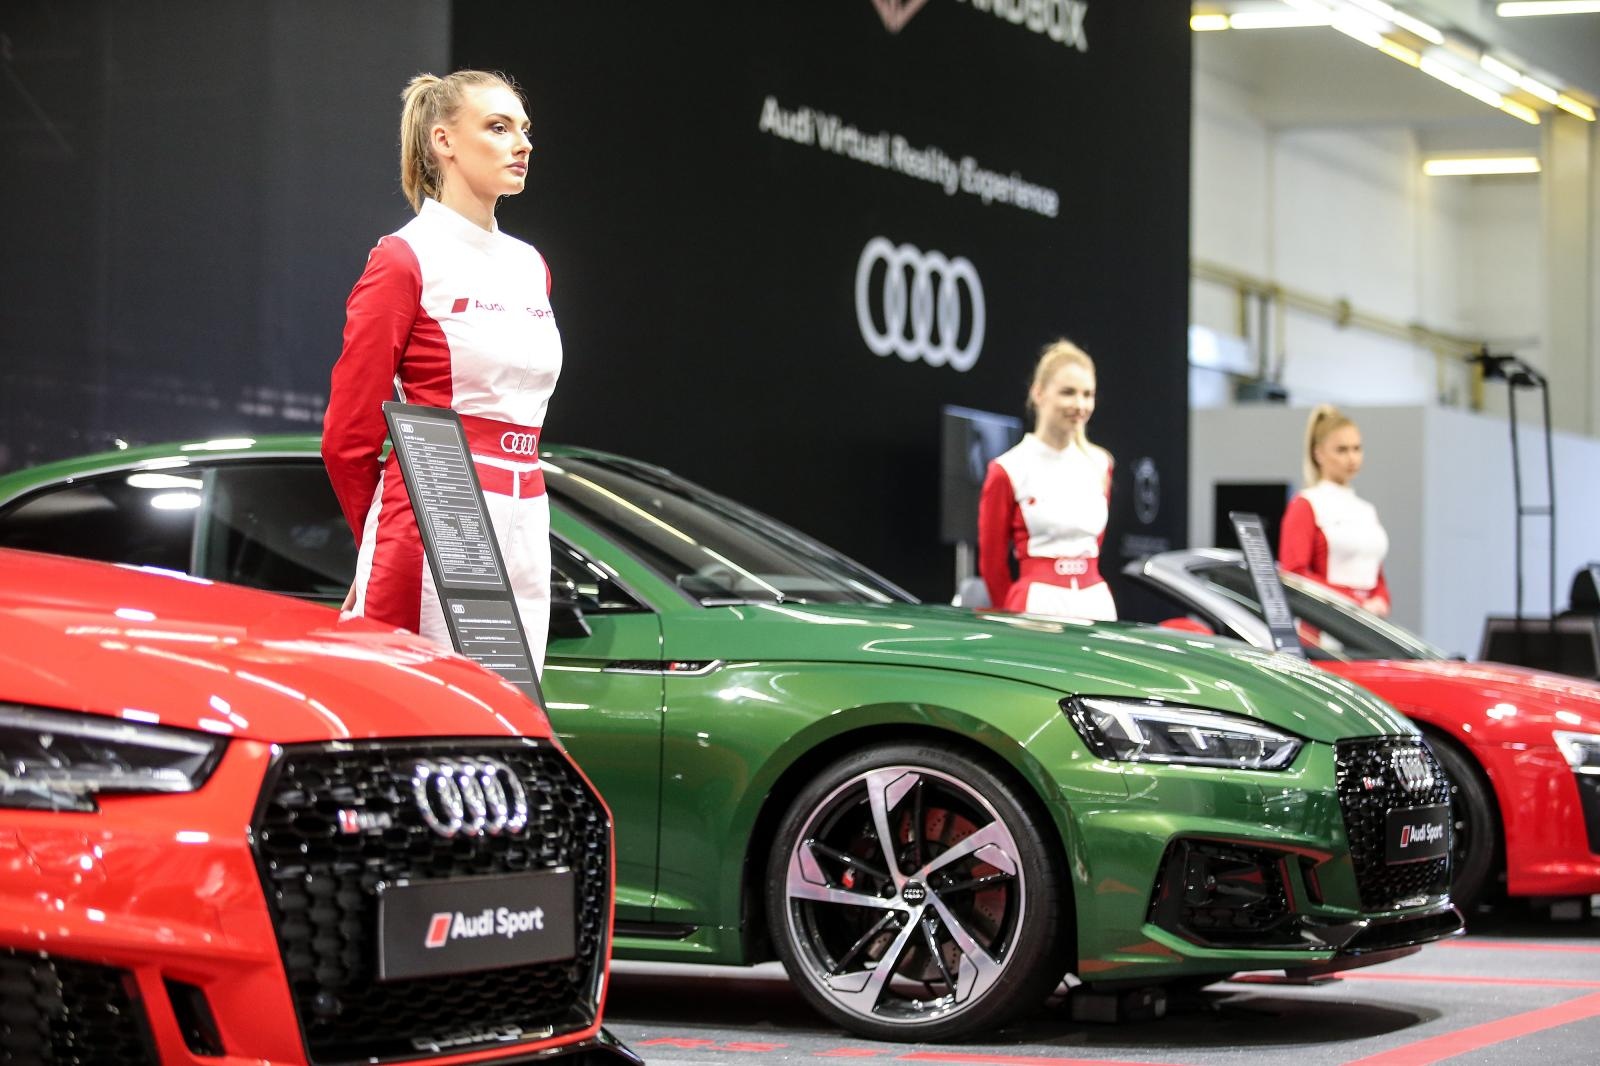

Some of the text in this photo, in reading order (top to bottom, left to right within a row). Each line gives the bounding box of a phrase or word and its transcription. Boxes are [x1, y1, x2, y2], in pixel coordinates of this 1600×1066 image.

[760, 96, 1060, 218] Audi Virtual Reality Experience
[1410, 823, 1443, 844] Audi Sport
[451, 906, 544, 939] Audi Sport
